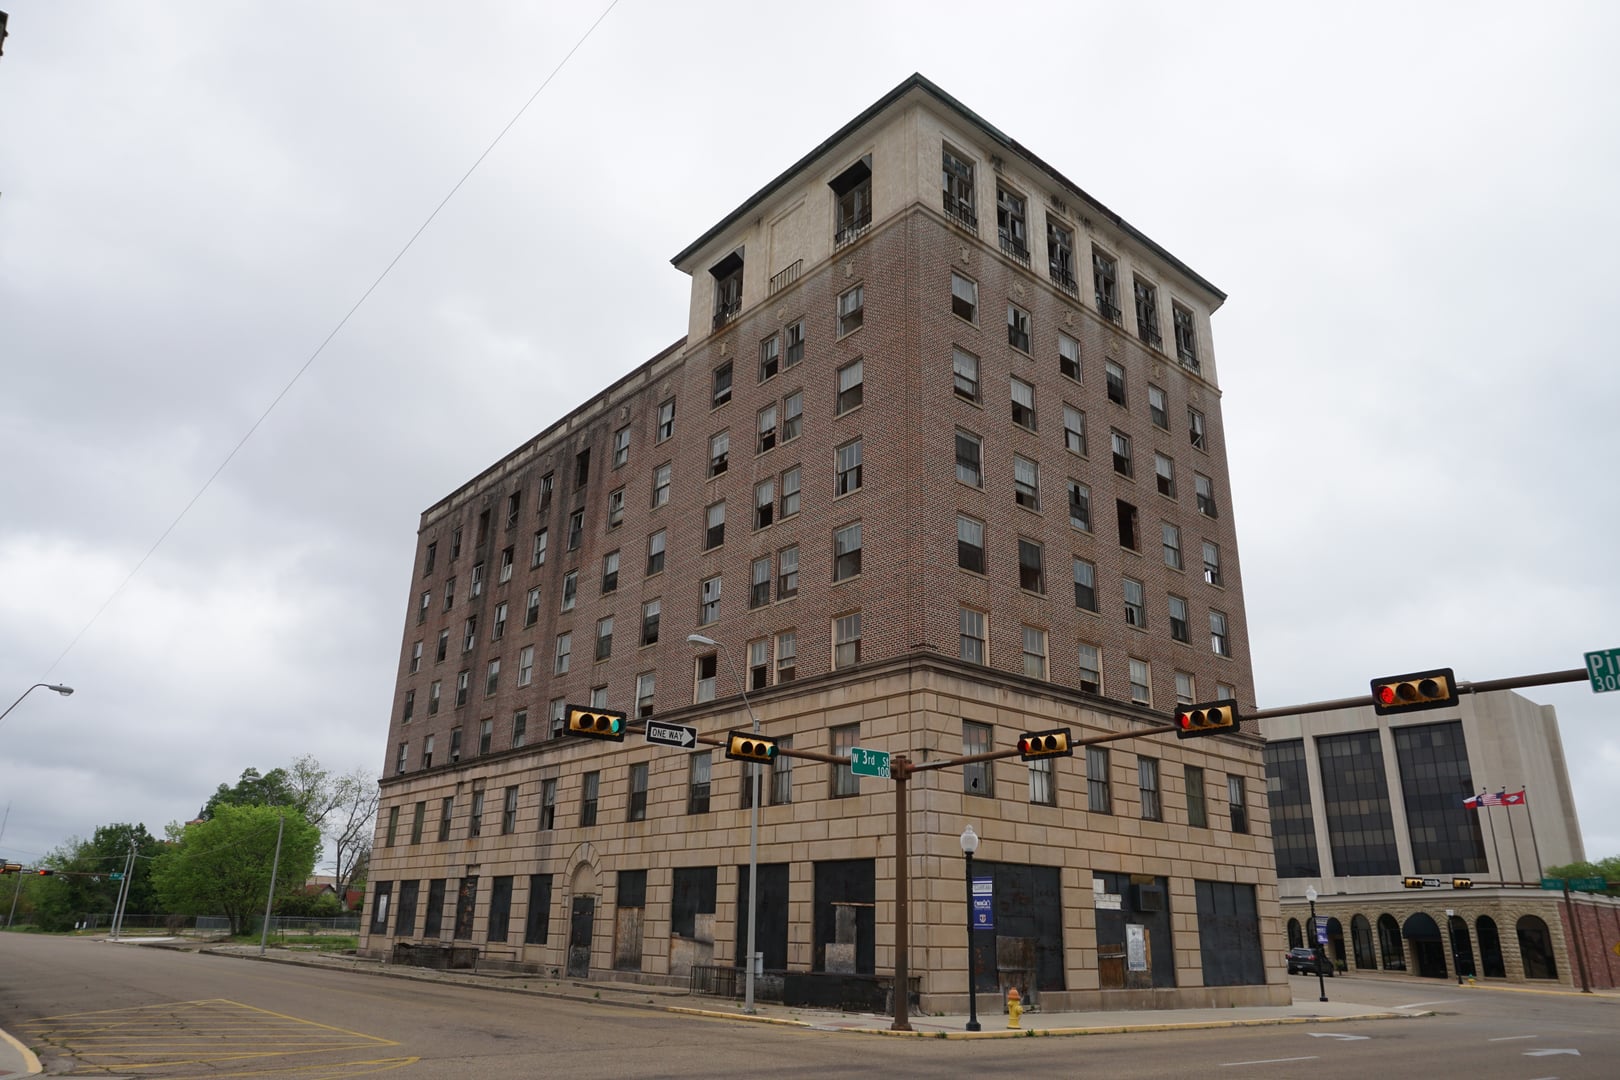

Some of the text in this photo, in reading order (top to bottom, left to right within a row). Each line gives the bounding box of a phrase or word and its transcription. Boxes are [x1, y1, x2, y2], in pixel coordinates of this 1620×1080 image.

[652, 728, 684, 740] ONE WAY
[853, 750, 889, 767] W 3rd St
[877, 766, 889, 777] 100
